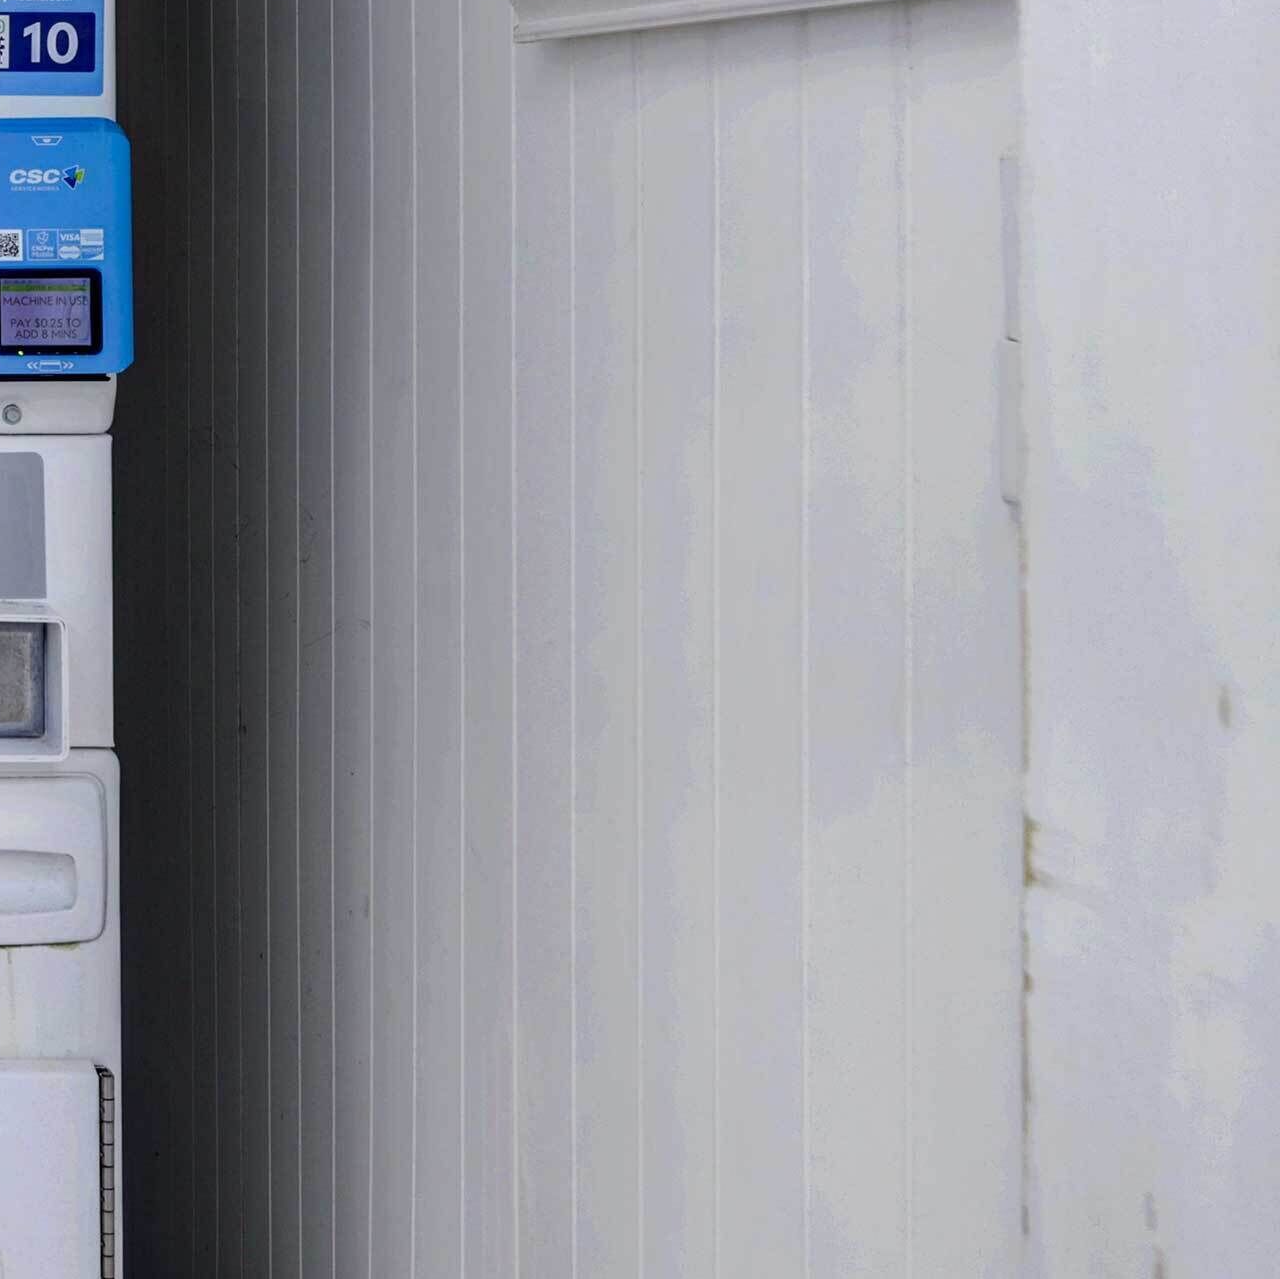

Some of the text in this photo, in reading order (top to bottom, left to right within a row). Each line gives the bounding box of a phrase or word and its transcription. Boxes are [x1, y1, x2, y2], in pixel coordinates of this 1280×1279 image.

[23, 22, 78, 64] 10
[9, 169, 60, 184] CSC
[3, 296, 89, 307] MACHINE IN USE
[10, 318, 32, 329] PAY
[67, 318, 81, 329] TO
[14, 328, 78, 340] ADD 8 MINS
